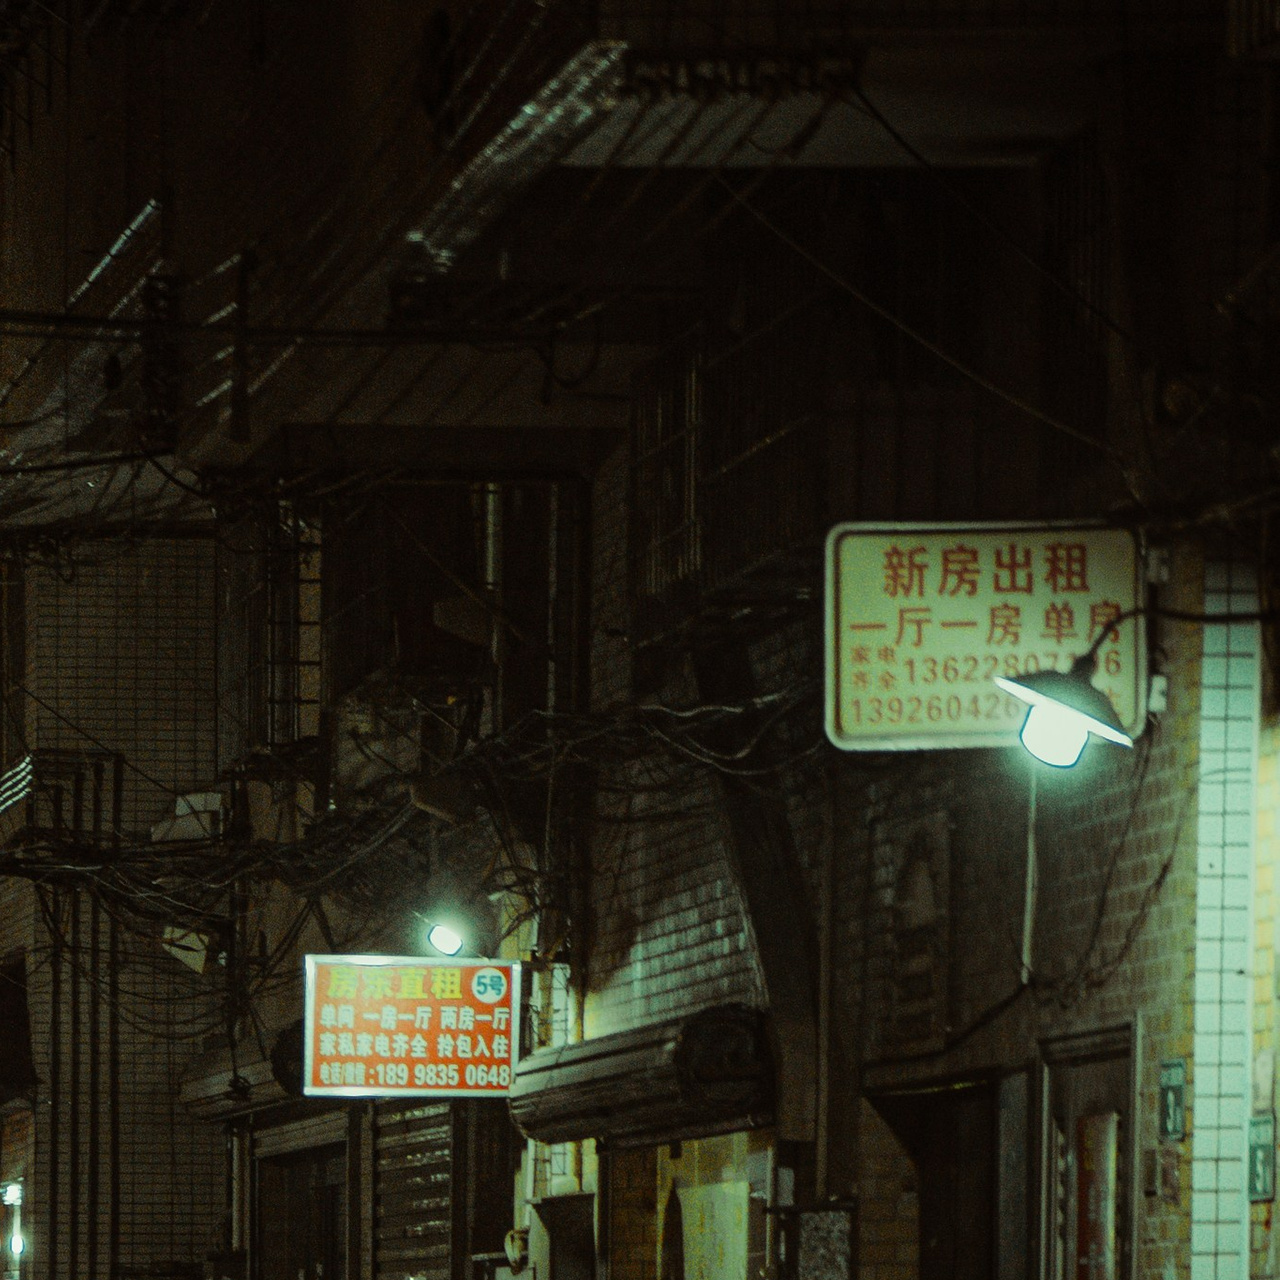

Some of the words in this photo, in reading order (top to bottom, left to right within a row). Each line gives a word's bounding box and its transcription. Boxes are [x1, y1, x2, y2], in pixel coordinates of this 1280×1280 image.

[883, 544, 1090, 597] 新房出租
[850, 602, 1022, 647] 一厅一房
[1040, 601, 1121, 645] 单房
[904, 650, 1121, 684] 136228076
[851, 694, 1022, 724] 139260426
[326, 967, 463, 999] 房东直租
[476, 975, 503, 996] 5号
[320, 1004, 354, 1028] 单间
[362, 1004, 432, 1030] 一房一厅
[440, 1005, 509, 1030] 两房一厅
[320, 1032, 428, 1058] 家私家电齐全
[437, 1034, 509, 1058] 拎包入住
[414, 1064, 459, 1086] 9835
[465, 1064, 510, 1087] 0648
